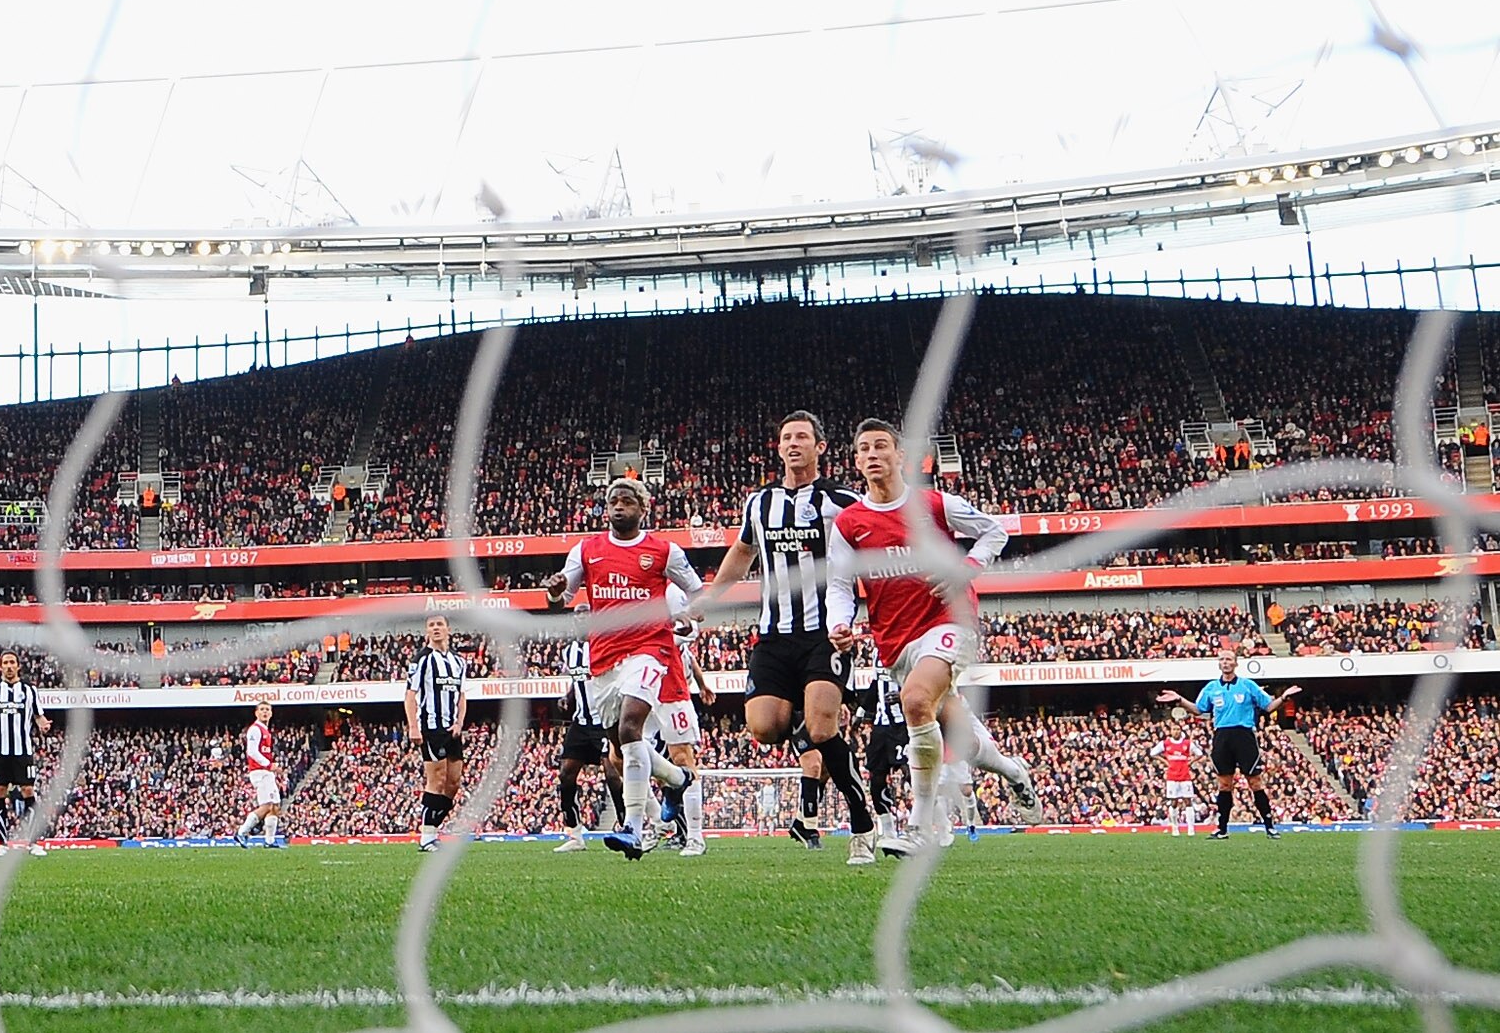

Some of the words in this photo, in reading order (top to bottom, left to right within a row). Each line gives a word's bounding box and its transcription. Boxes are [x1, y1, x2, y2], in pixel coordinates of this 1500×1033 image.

[1368, 503, 1414, 518] 1993
[1059, 516, 1102, 530] 1993
[765, 527, 820, 541] northern
[485, 540, 525, 554] 1989
[220, 551, 259, 565] 1987
[608, 571, 629, 587] Fly
[1084, 571, 1142, 588] Arsenal
[592, 584, 651, 601] Emirates
[941, 632, 957, 649] 6
[830, 652, 843, 676] 6
[641, 665, 660, 687] 17
[1000, 665, 1134, 682] NIKEFOOTBALL.COM
[79, 692, 132, 704] Australia
[671, 711, 689, 730] 18
